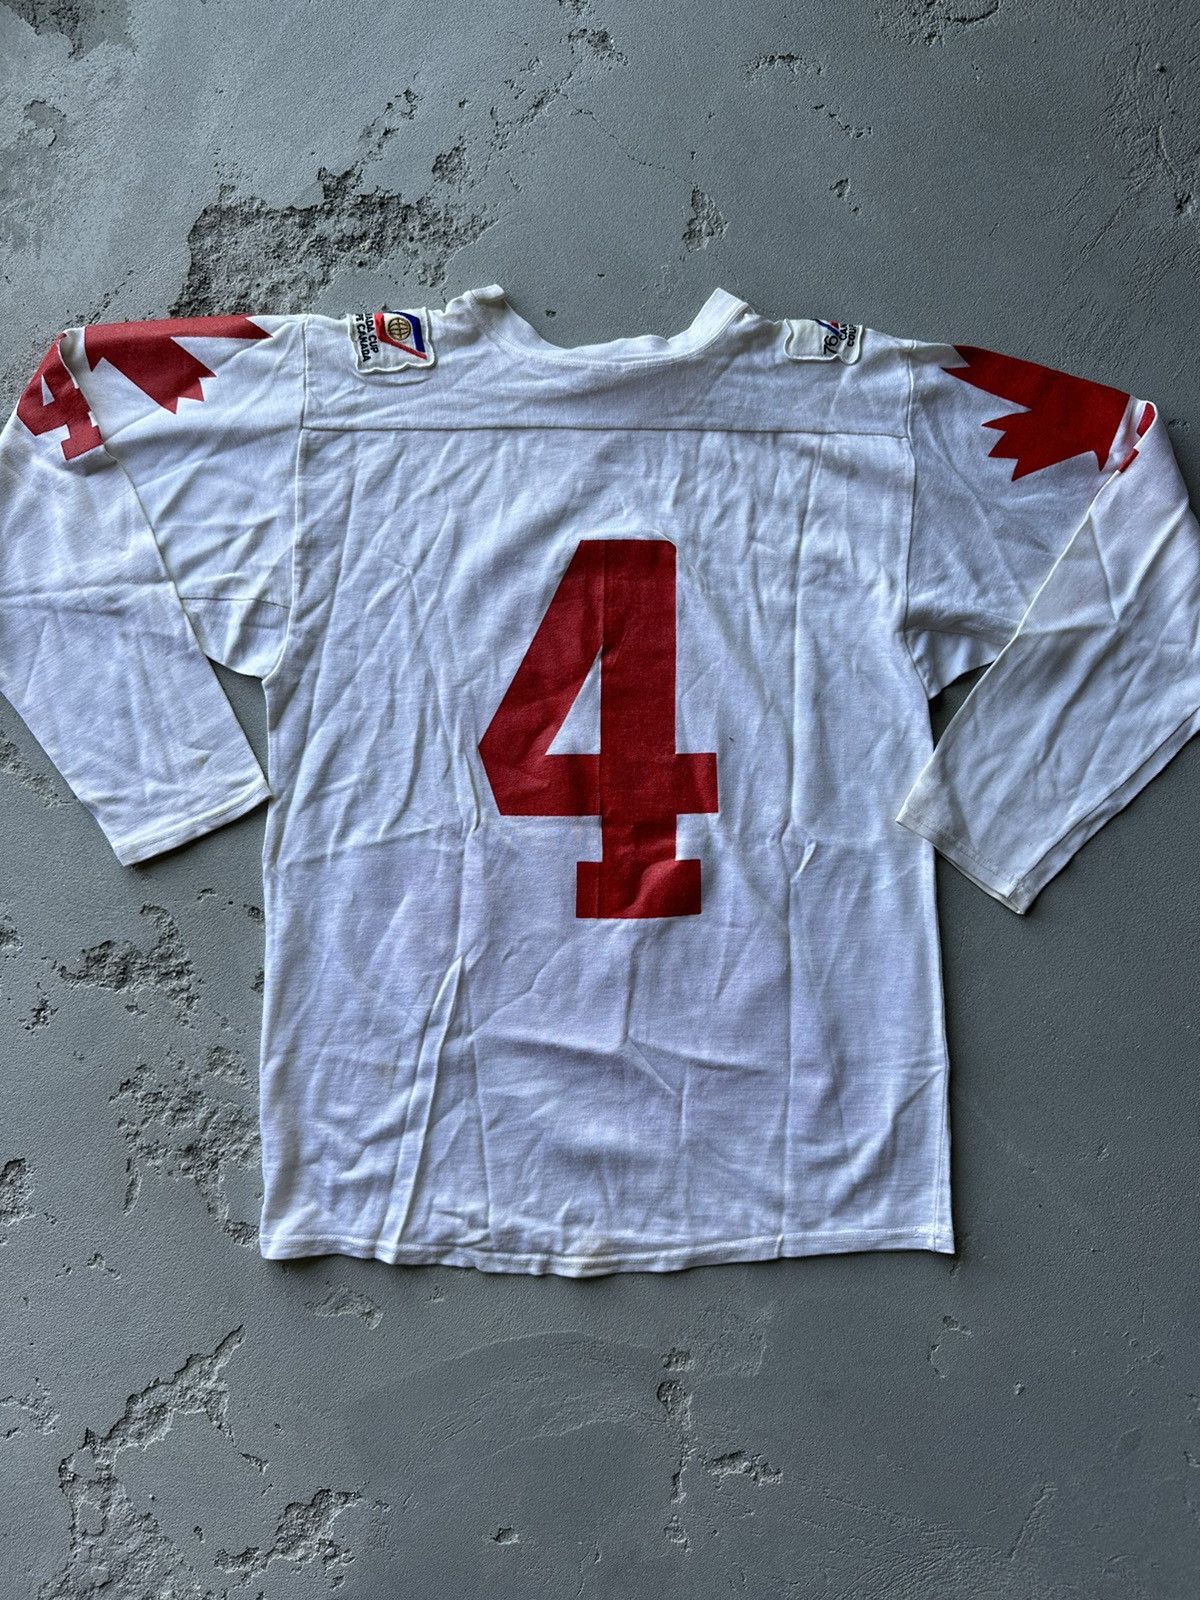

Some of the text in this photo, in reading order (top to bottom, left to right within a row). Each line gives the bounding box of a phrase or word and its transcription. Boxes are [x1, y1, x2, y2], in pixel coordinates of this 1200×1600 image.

[357, 324, 371, 362] CANADA
[368, 334, 379, 353] CUP
[823, 335, 838, 355] 76
[17, 333, 104, 460] 4
[478, 540, 718, 918] 4
